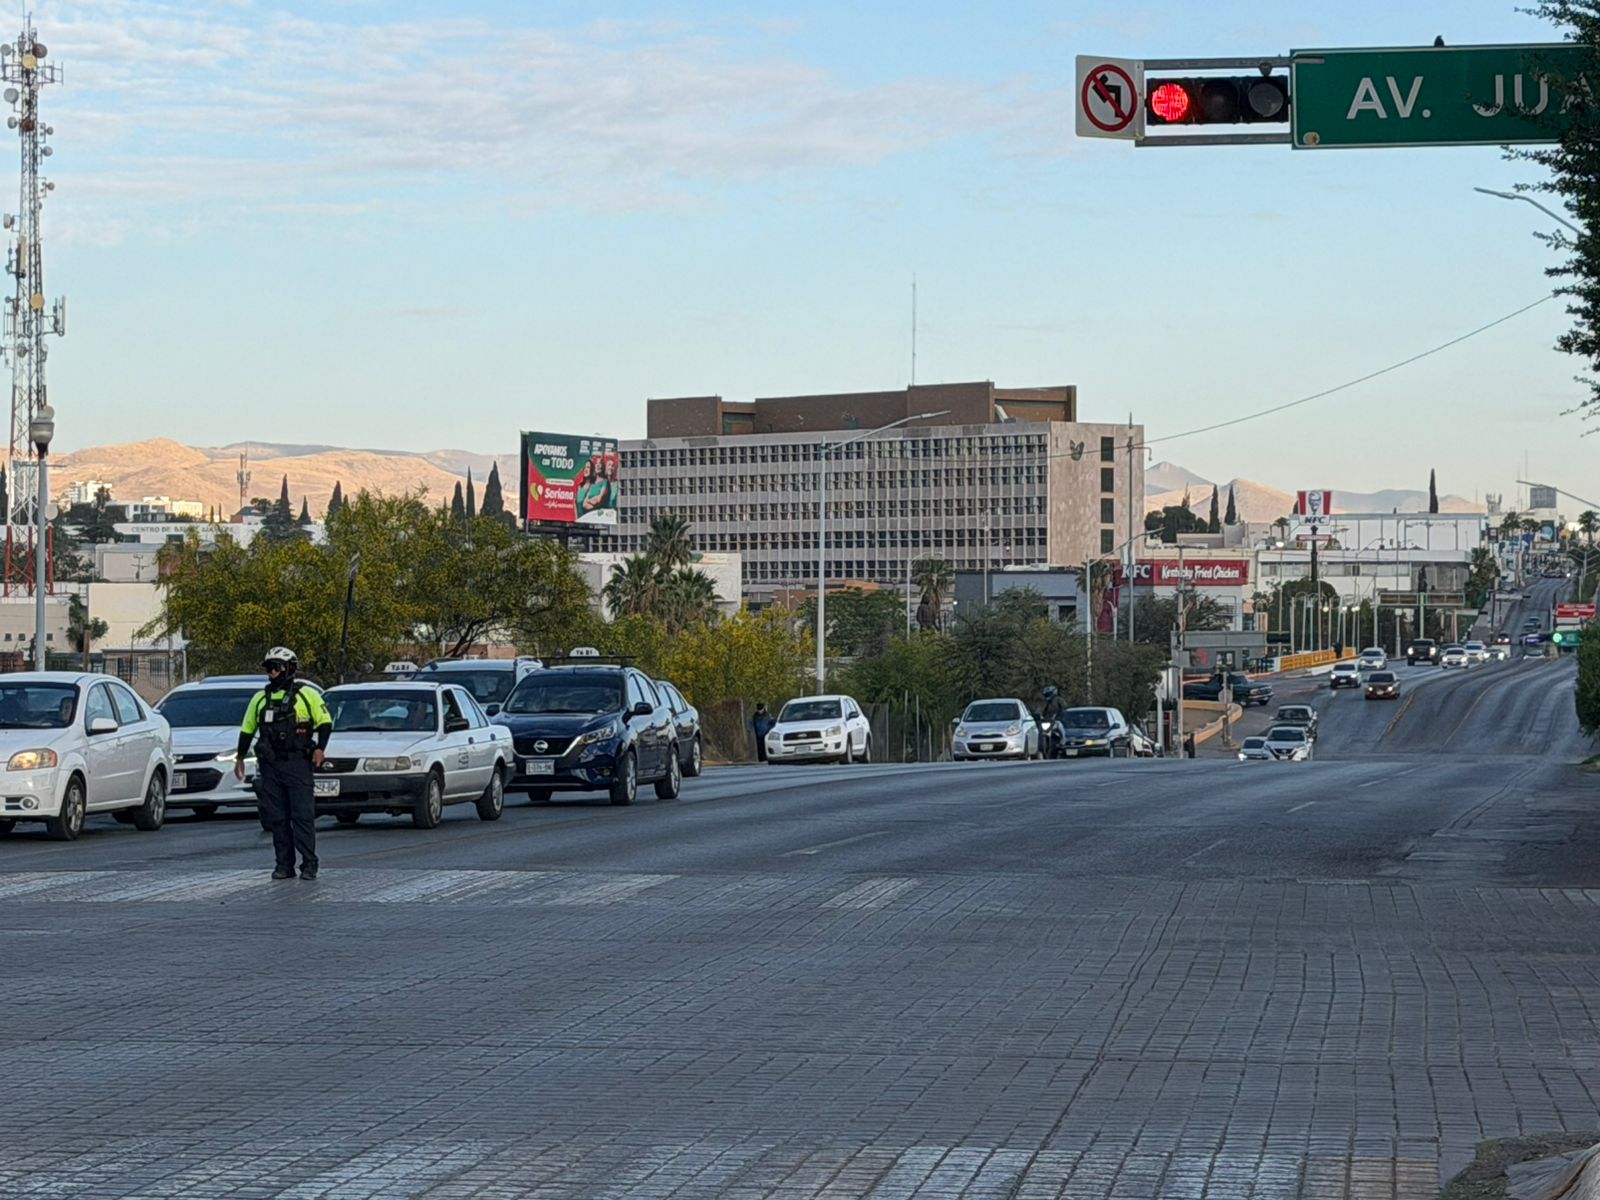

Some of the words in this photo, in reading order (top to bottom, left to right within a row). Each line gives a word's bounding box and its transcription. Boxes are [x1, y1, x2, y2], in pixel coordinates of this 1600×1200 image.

[1346, 76, 1431, 119] AV.
[551, 457, 574, 470] TODO
[544, 487, 574, 500] Soriana
[1304, 516, 1325, 524] KFC
[131, 525, 160, 533] CENTRO
[1121, 564, 1151, 578] KFC
